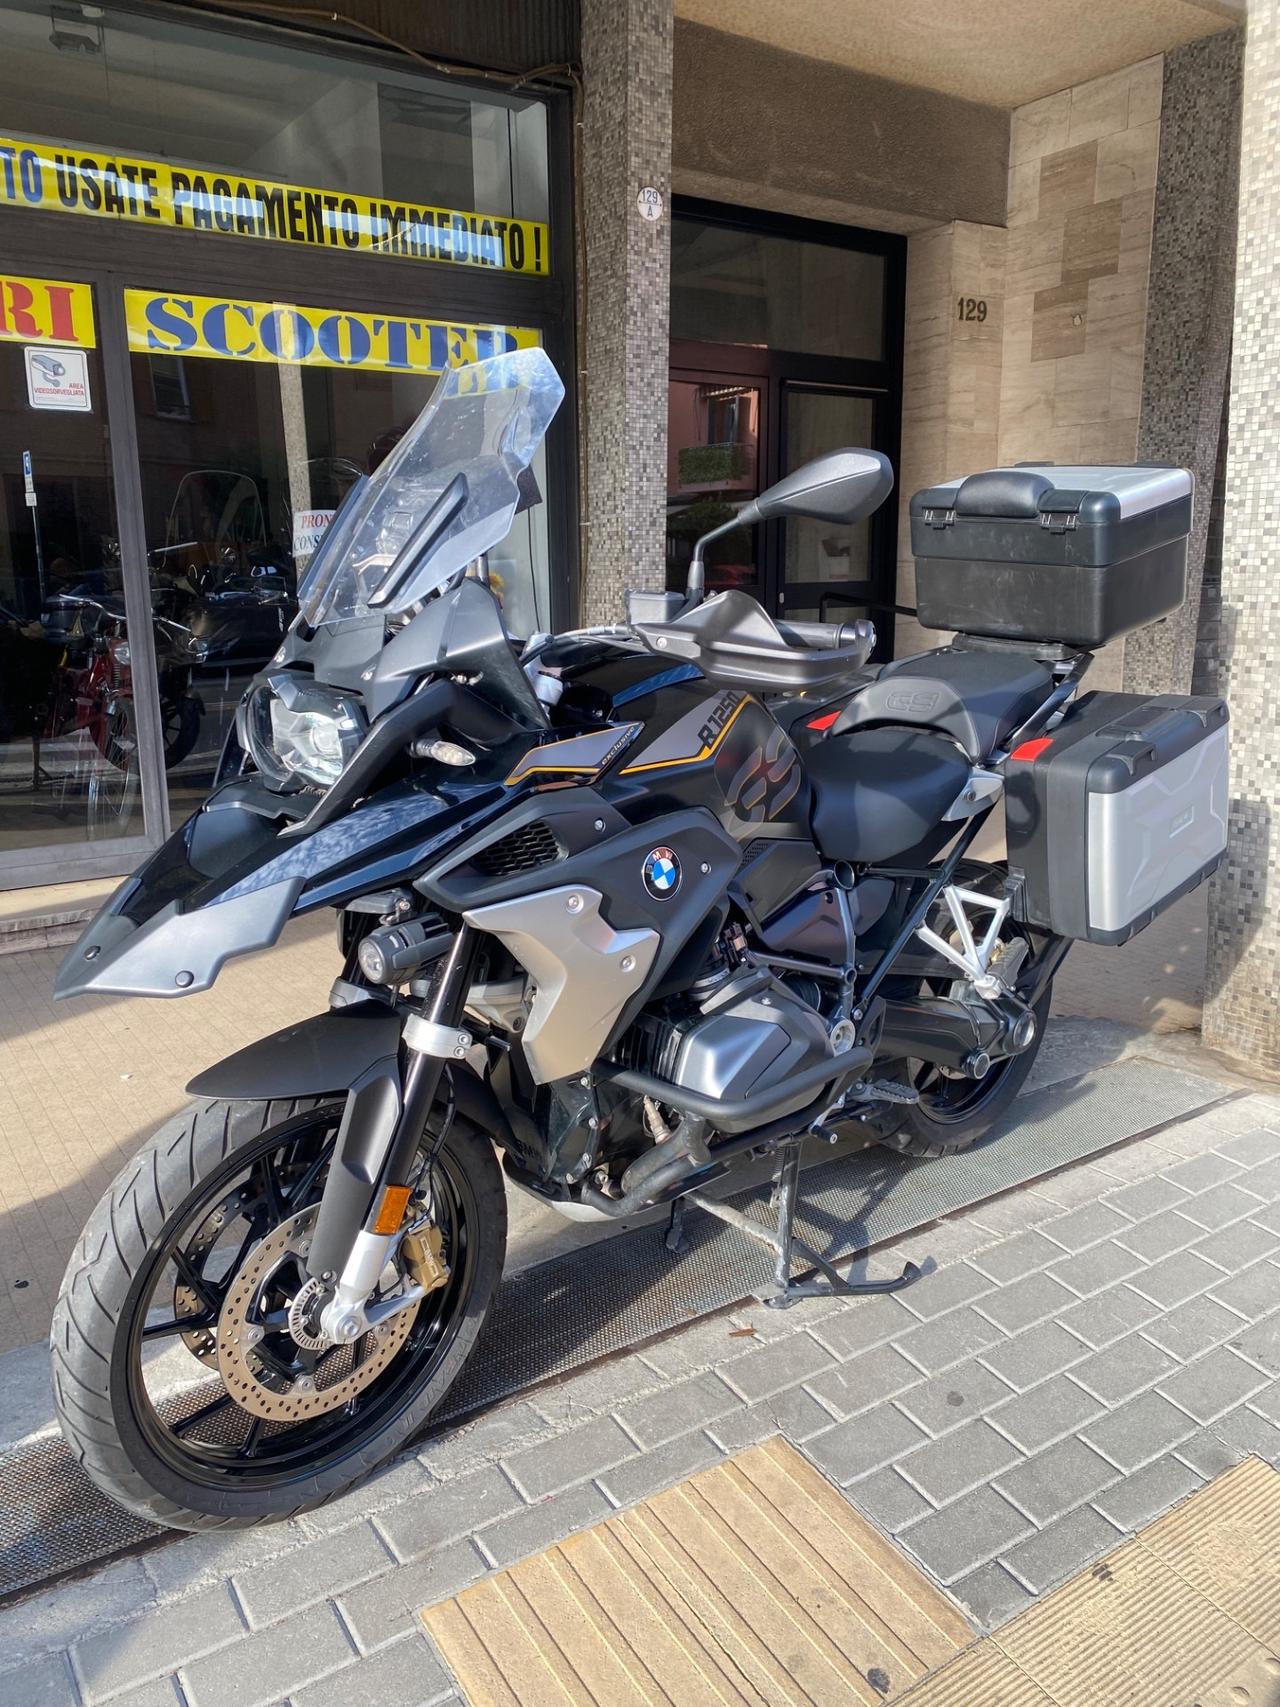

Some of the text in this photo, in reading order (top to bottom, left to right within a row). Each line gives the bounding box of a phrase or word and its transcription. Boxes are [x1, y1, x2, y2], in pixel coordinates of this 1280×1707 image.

[642, 190, 658, 203] 129
[54, 154, 161, 218] USATE
[171, 171, 359, 248] PAGAMENTO
[370, 202, 525, 270] IMMEDIATO
[647, 205, 653, 217] A
[957, 297, 987, 322] 129
[885, 690, 940, 713] GS
[601, 726, 635, 765] exclusive
